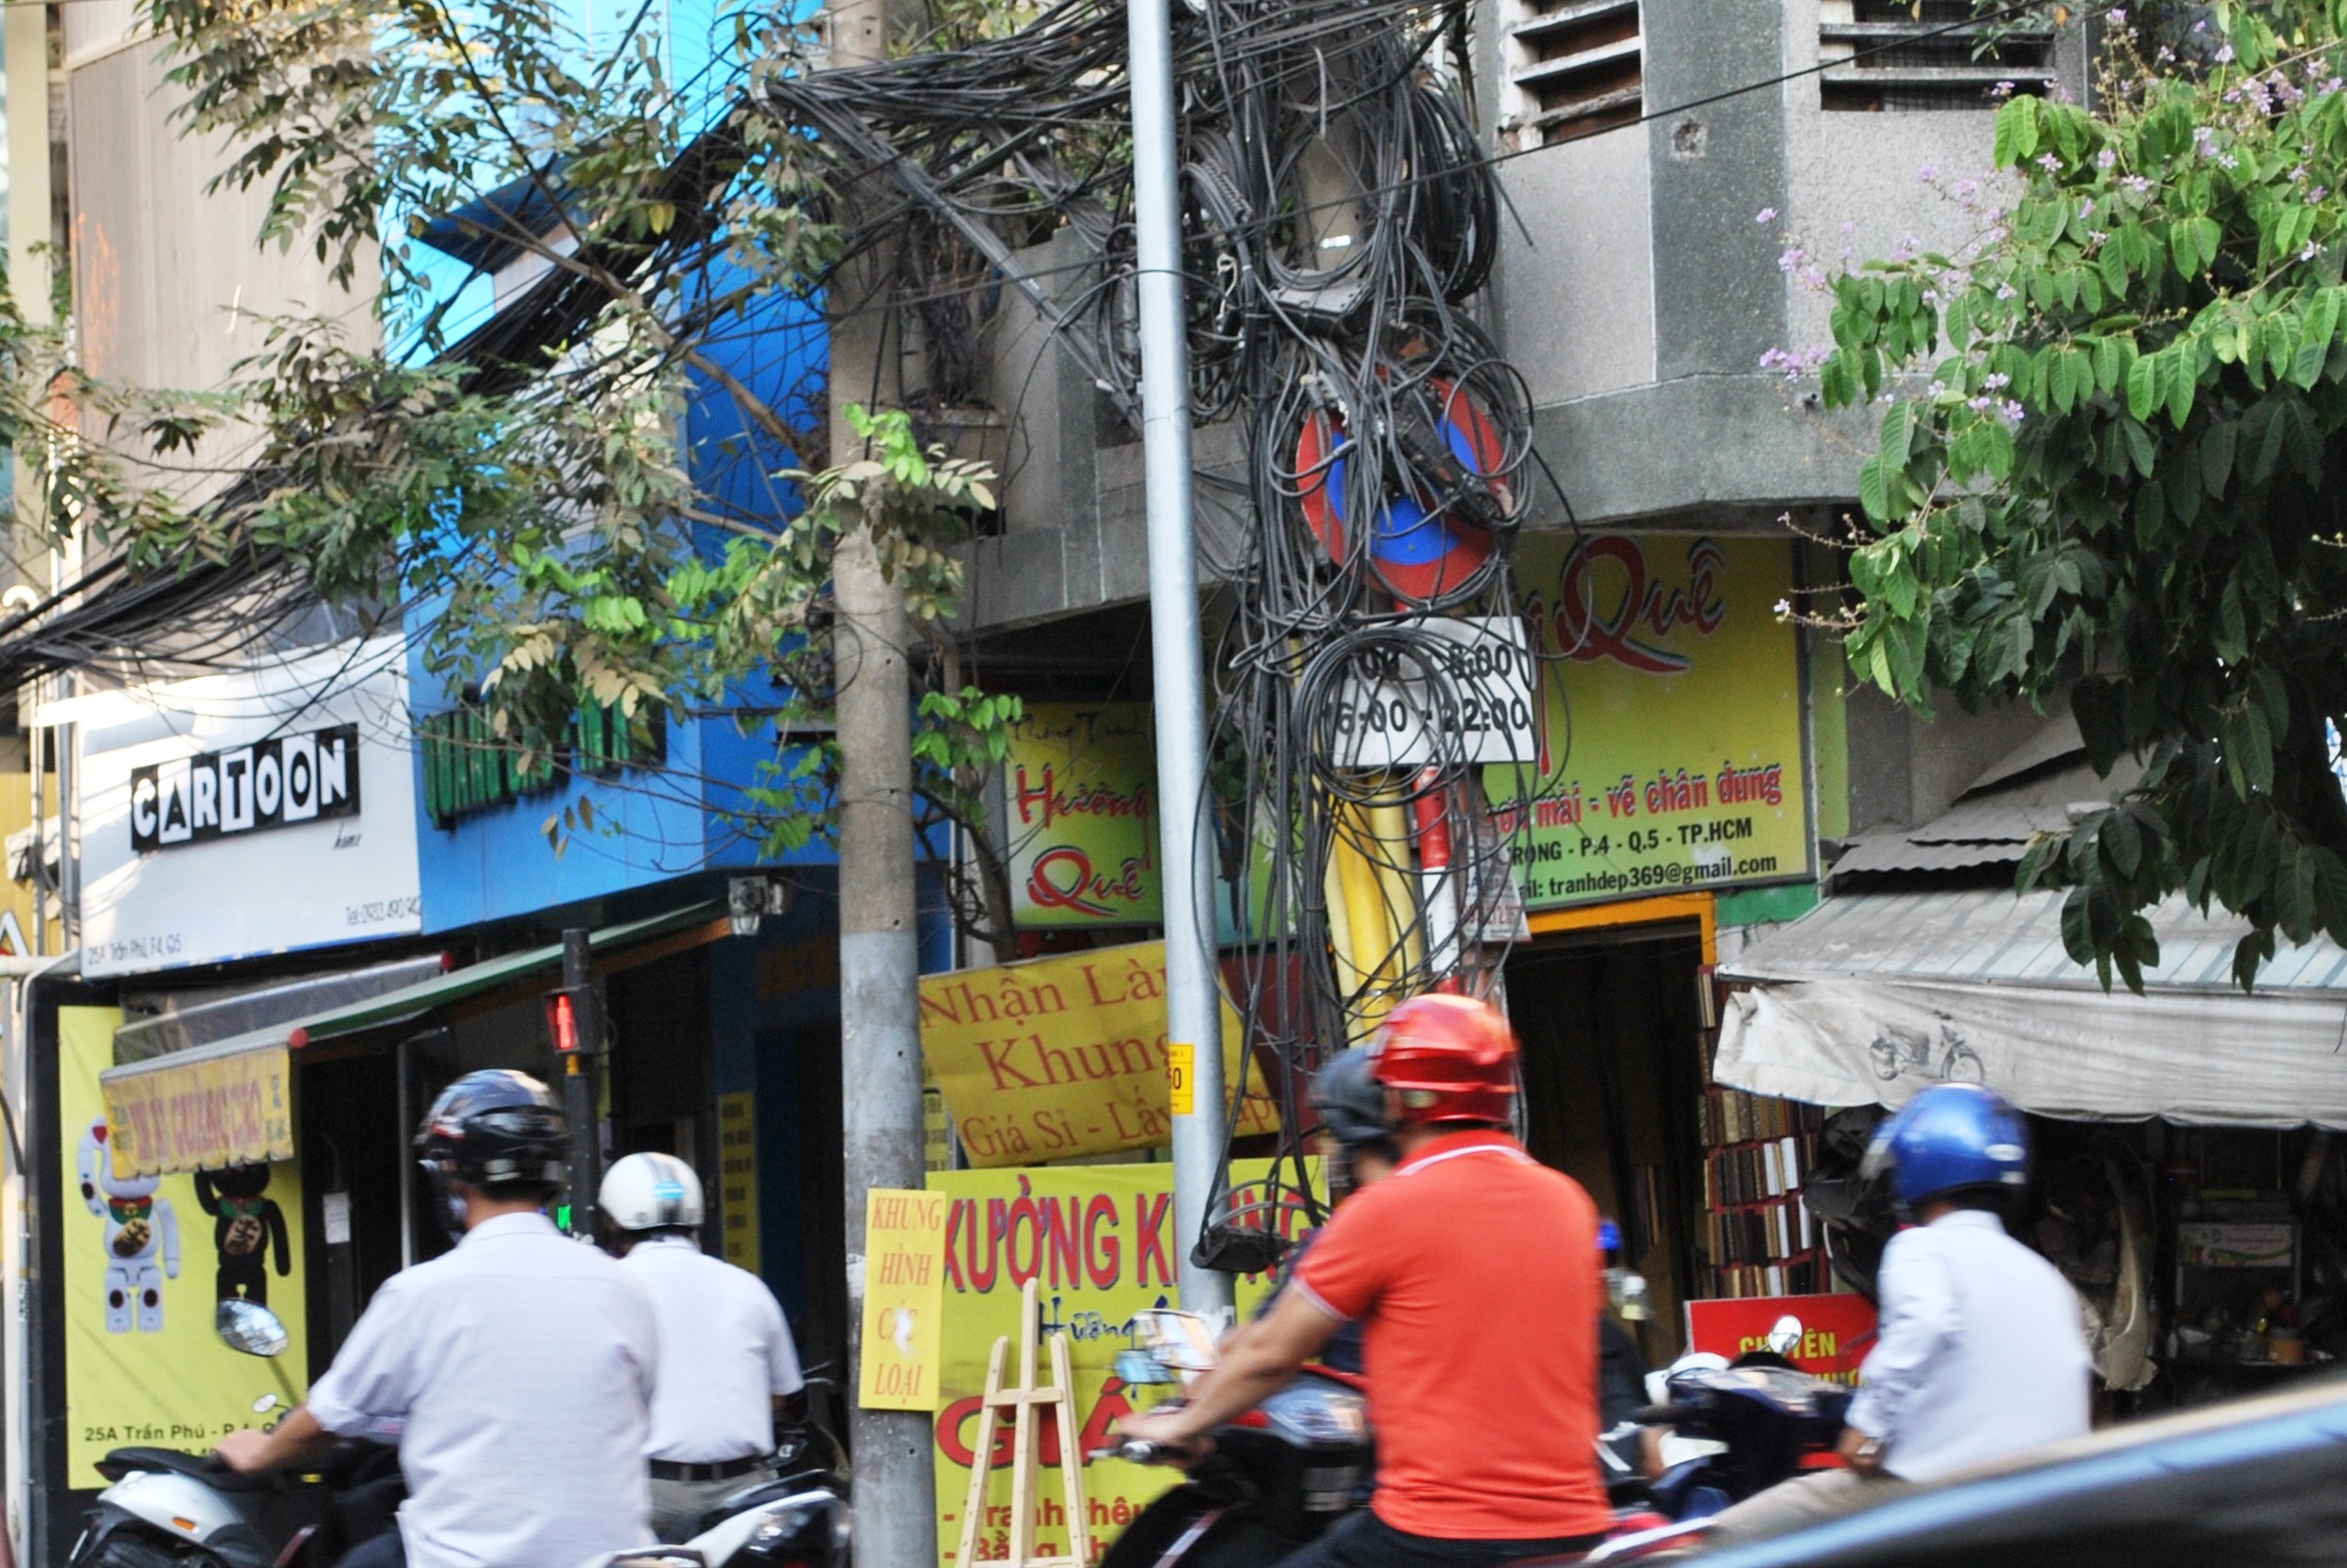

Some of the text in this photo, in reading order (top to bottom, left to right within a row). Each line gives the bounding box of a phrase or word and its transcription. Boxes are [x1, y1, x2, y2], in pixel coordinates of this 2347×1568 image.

[1555, 535, 1728, 675] Quê
[133, 731, 352, 845] CARTOON
[1646, 766, 1710, 814] chân
[1716, 759, 1783, 807] dung
[1581, 834, 1610, 858] P.4
[1628, 828, 1658, 852] Q.5
[1678, 817, 1753, 846] TP.HCM
[1027, 846, 1144, 918] Quê
[1550, 854, 1778, 894] tranhdep369@gmail.com
[919, 958, 1168, 1028] Nhận Là
[962, 1111, 1032, 1158] Giá
[872, 1197, 942, 1231] KHUNG
[945, 1173, 1120, 1294] XƯỞNG
[879, 1243, 932, 1286] HÌNH
[874, 1363, 923, 1405] LOẠI
[85, 1427, 117, 1442] 25A
